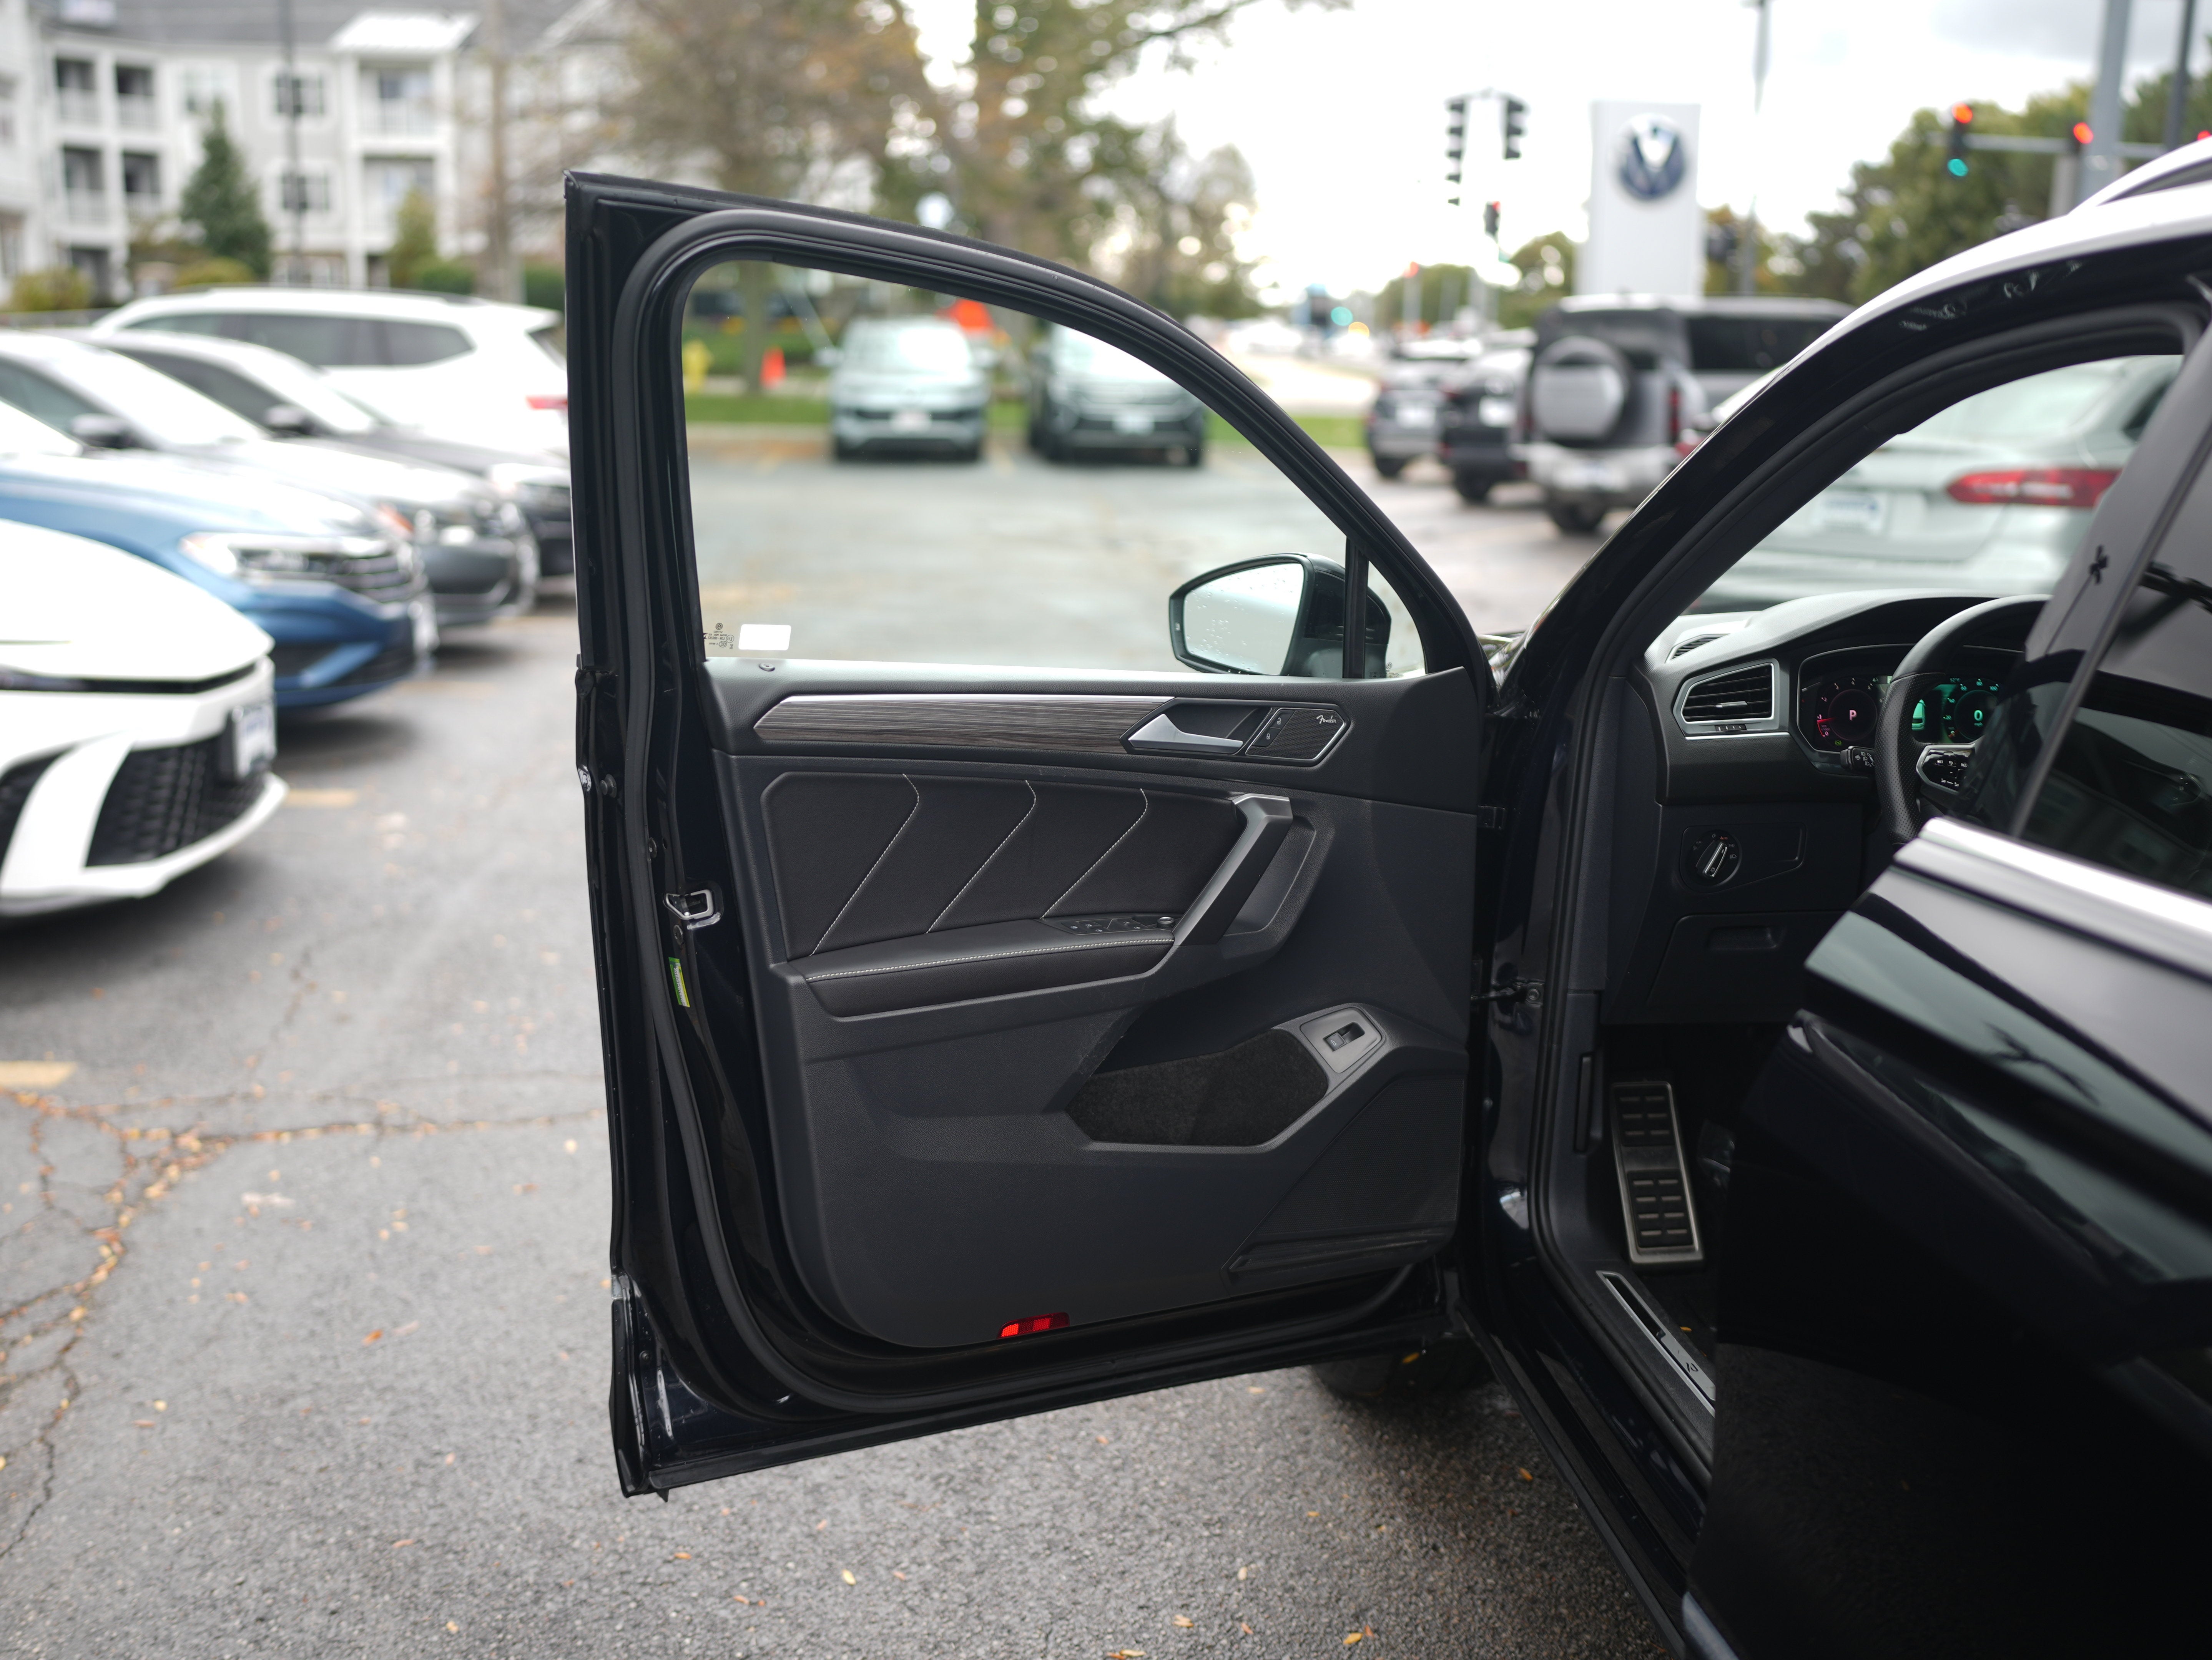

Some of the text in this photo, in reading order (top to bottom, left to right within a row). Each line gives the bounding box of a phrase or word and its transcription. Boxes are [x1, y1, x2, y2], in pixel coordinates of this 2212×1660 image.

[1316, 715, 1337, 724] Fender
[1849, 710, 1857, 721] P
[1974, 710, 1983, 722] 0
